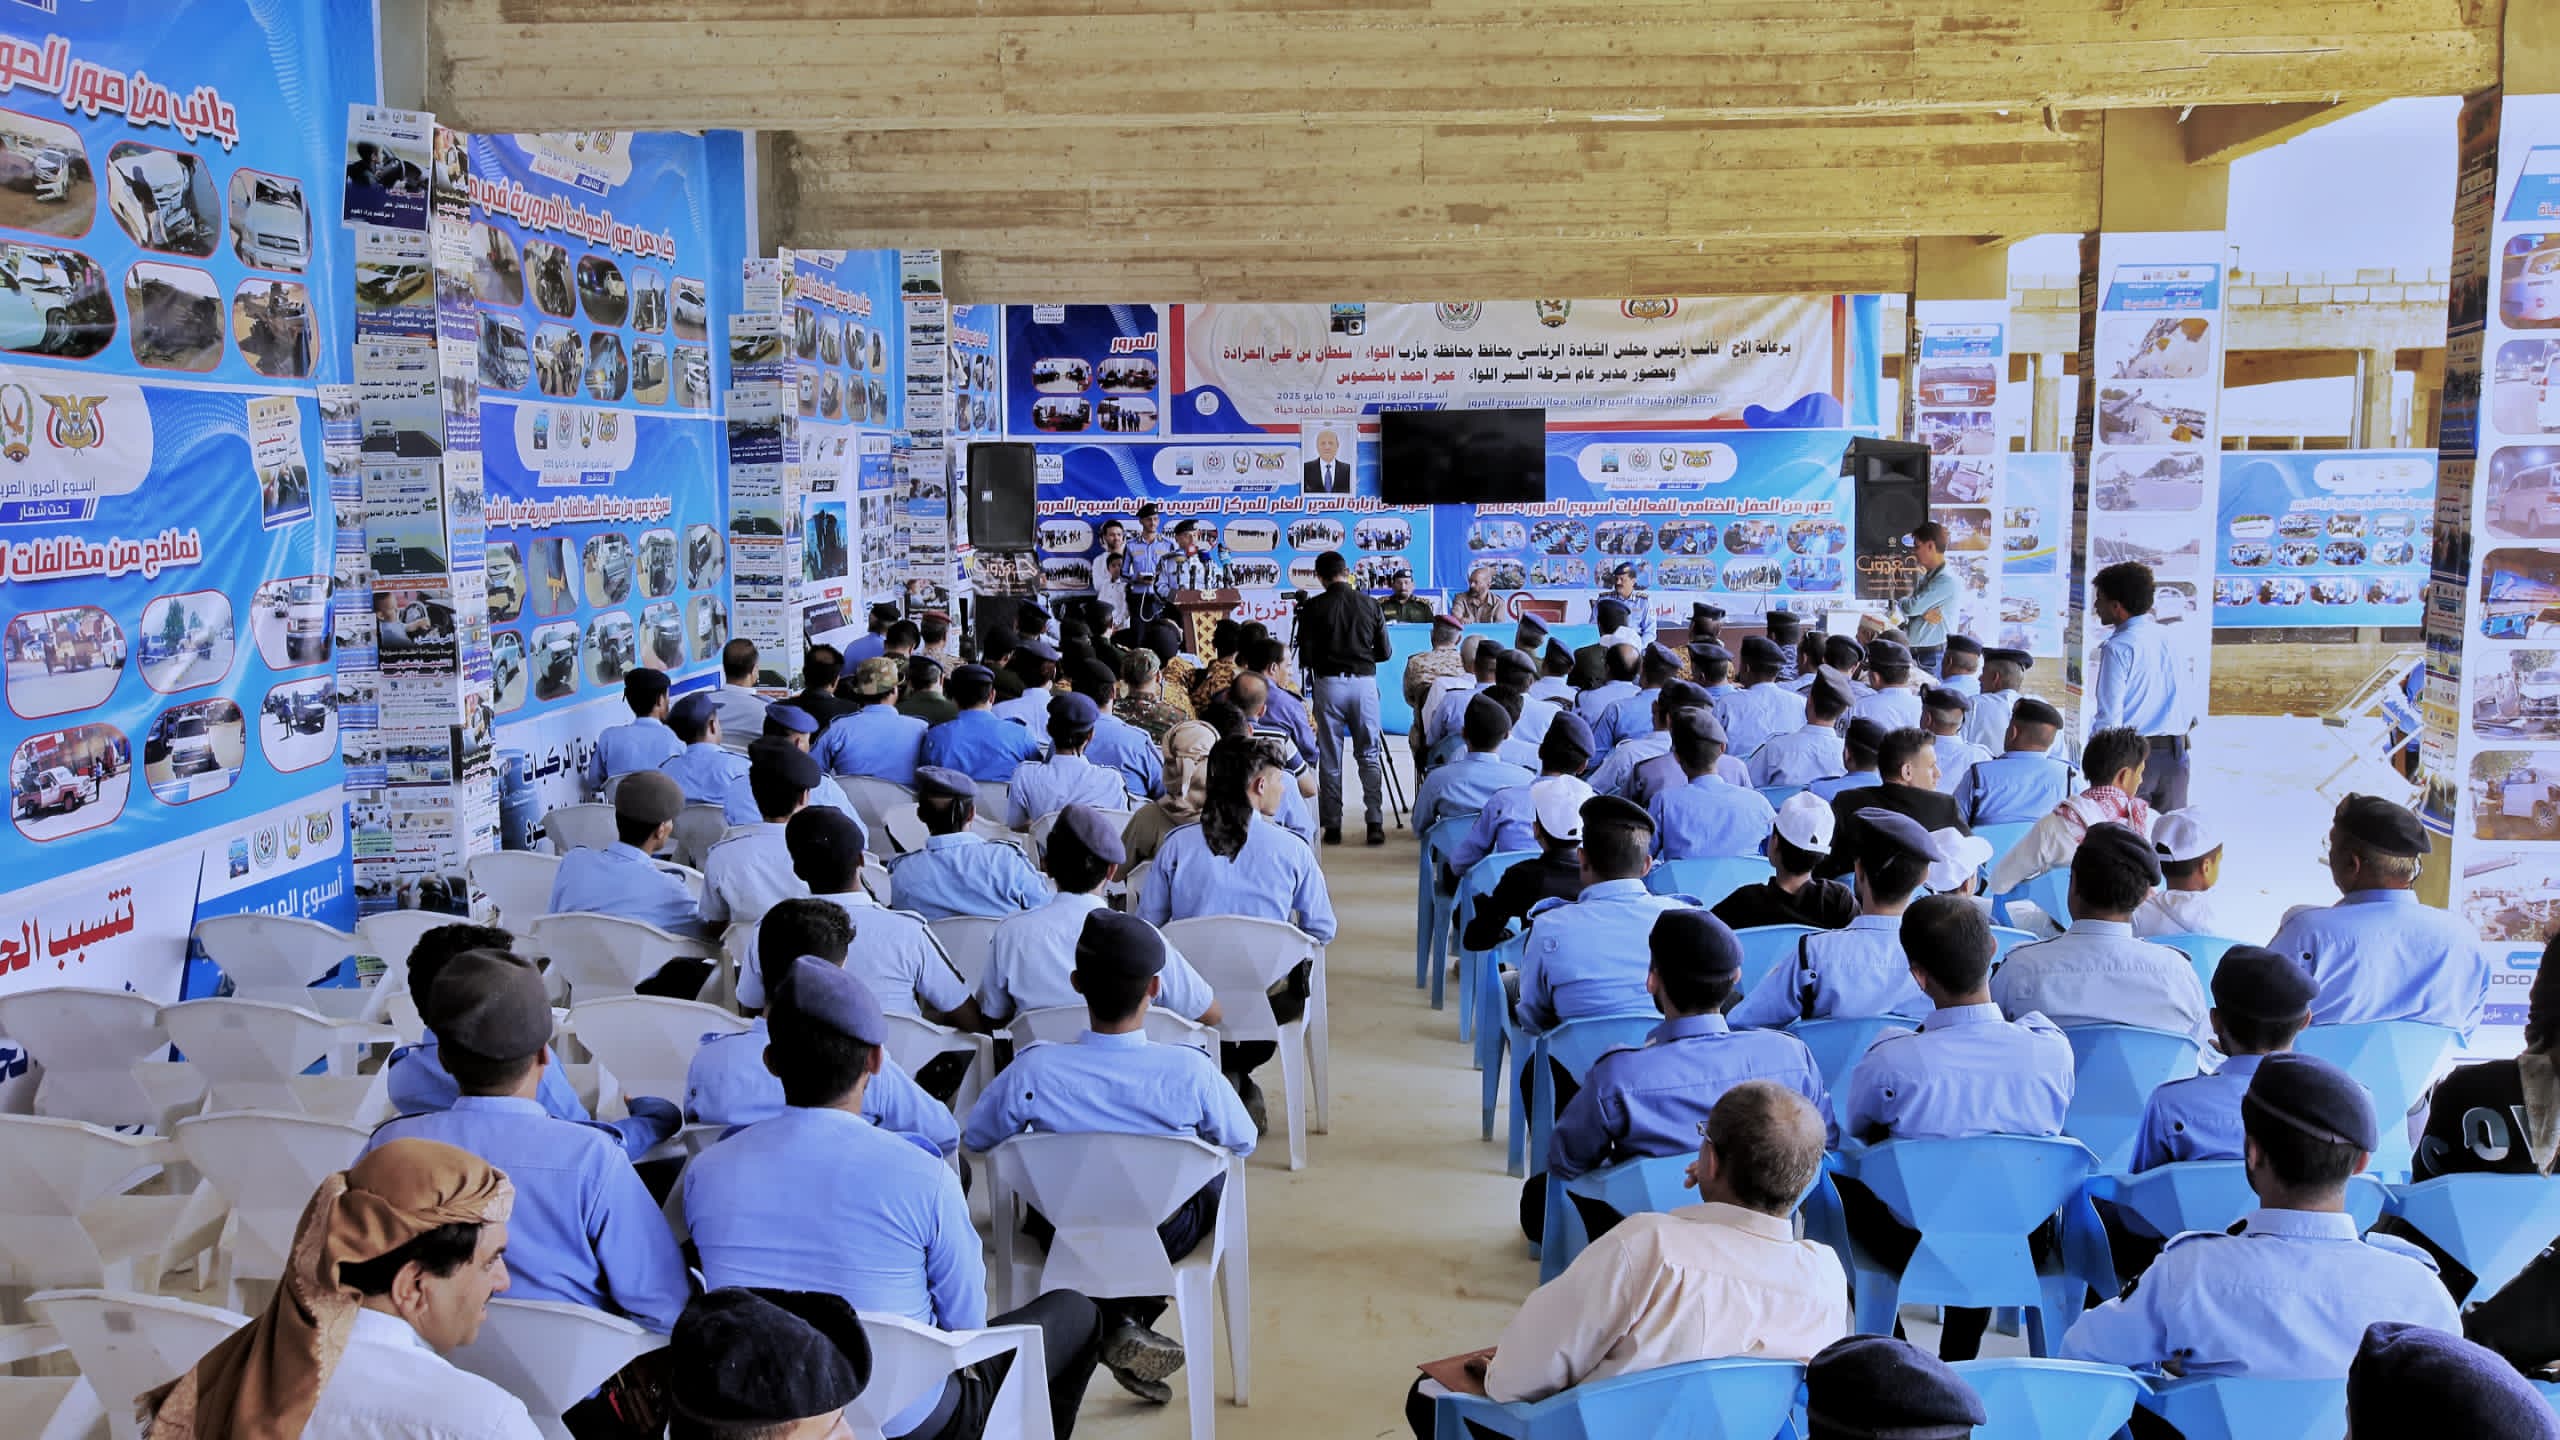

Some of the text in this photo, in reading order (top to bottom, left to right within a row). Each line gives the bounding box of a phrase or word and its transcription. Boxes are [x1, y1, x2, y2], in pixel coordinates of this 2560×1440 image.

[65, 64, 126, 112] صور
[128, 74, 169, 123] من
[172, 88, 238, 148] جانب
[566, 201, 610, 244] الحوادث
[1111, 332, 1157, 353] المرور
[1399, 341, 1428, 361] مأرب
[1434, 343, 1473, 359] محافظة
[1478, 343, 1512, 358] محافظ
[1569, 343, 1608, 360] القيادة
[1613, 342, 1648, 359] مجلس
[1654, 341, 1686, 359] رئيس
[1691, 341, 1719, 356] نائب
[1756, 339, 1791, 358] برعاية
[1223, 345, 1265, 362] العرادة
[1268, 346, 1293, 364] علي
[1296, 349, 1311, 362] بن
[1316, 345, 1353, 362] سلطان
[1366, 345, 1394, 361] اللواء
[1517, 343, 1564, 361] الرئاسي
[1336, 367, 1396, 385] بامشموس
[1432, 369, 1455, 384] عمر
[1469, 367, 1497, 383] اللواء
[1502, 367, 1533, 384] السير
[1537, 366, 1571, 383] شرطة
[1575, 366, 1594, 384] عام
[1599, 367, 1627, 382] مدير
[1632, 366, 1677, 382] وبحضور
[1276, 391, 1301, 401] 2025
[1303, 390, 1324, 402] مايو
[1325, 391, 1336, 400] 10
[1344, 391, 1351, 400] 4
[1387, 388, 1416, 401] المرور
[28, 479, 59, 497] المرور
[63, 476, 96, 495] أسبوع
[19, 502, 71, 521] تحت شعار
[563, 496, 602, 521] المخالفات
[1037, 496, 1075, 515] المرور
[1076, 497, 1120, 516] اسبوع
[1166, 496, 1219, 515] التدريبي
[1224, 496, 1267, 515] للمركز
[1271, 496, 1303, 514] العام
[1307, 496, 1347, 514] المدير
[1348, 496, 1378, 513] زيارة
[1526, 498, 1567, 516] المرور
[1568, 499, 1613, 517] اسبوع
[1616, 498, 1677, 516] للفعاليات
[1680, 498, 1735, 517] الختامي
[1737, 498, 1779, 515] الحفل
[1781, 500, 1802, 514] من
[1806, 501, 1832, 514] صور
[12, 540, 104, 577] مخالفات
[108, 541, 141, 572] من
[144, 531, 199, 574] نماذج
[1255, 600, 1288, 621] تزرع
[256, 866, 344, 918] أسبوع المرو
[48, 885, 135, 970] تتسبب
